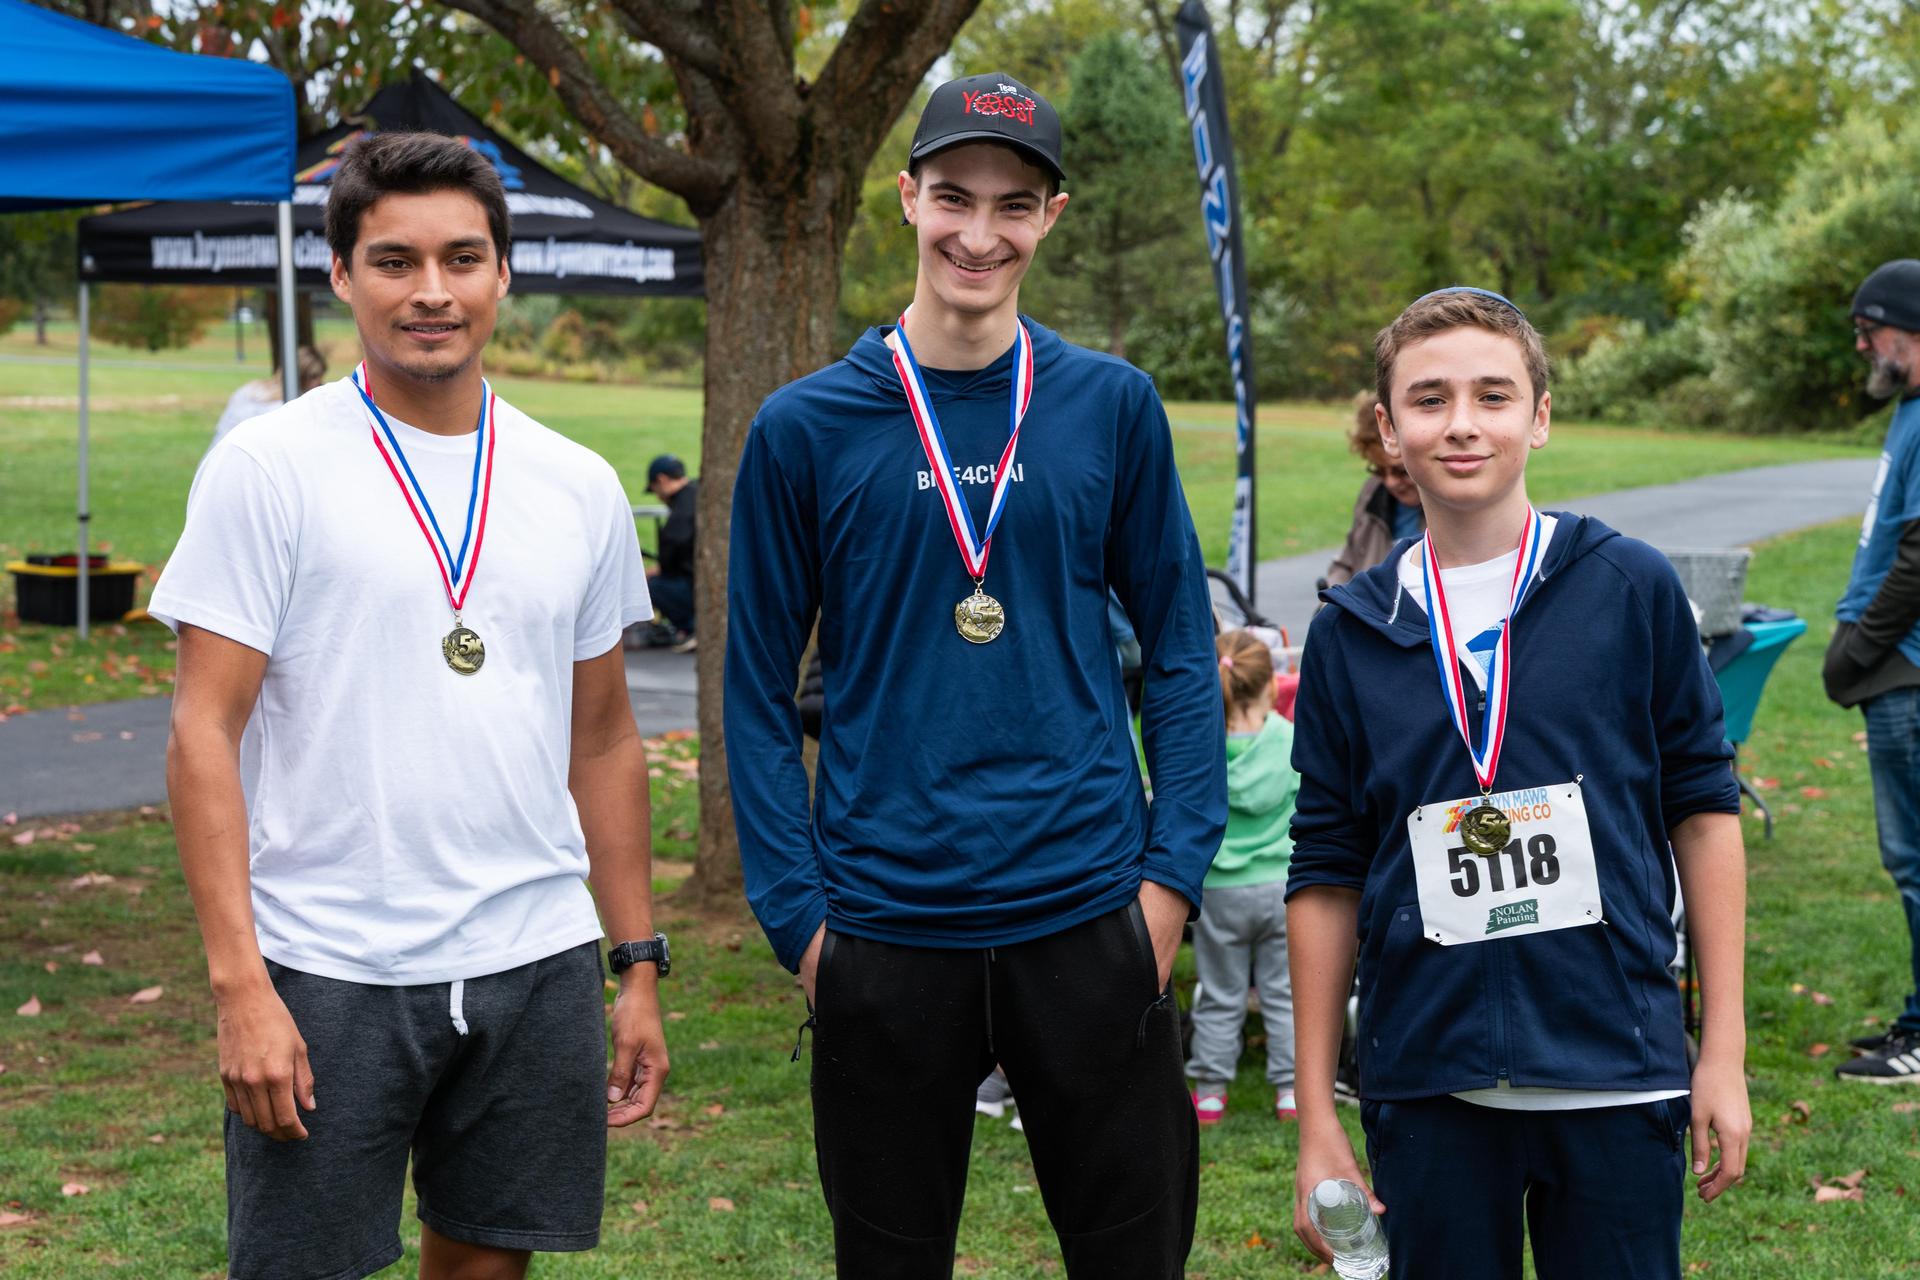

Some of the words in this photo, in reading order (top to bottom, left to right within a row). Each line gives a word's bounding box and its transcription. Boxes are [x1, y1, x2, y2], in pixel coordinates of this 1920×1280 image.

[997, 83, 1017, 93] Team
[972, 602, 1003, 624] 5K
[1512, 788, 1549, 808] MAWR
[1533, 804, 1551, 819] CO
[1476, 813, 1510, 835] 5K
[1447, 833, 1560, 897] 5118
[1495, 903, 1534, 917] NOLAN
[1497, 912, 1536, 925] Painting
